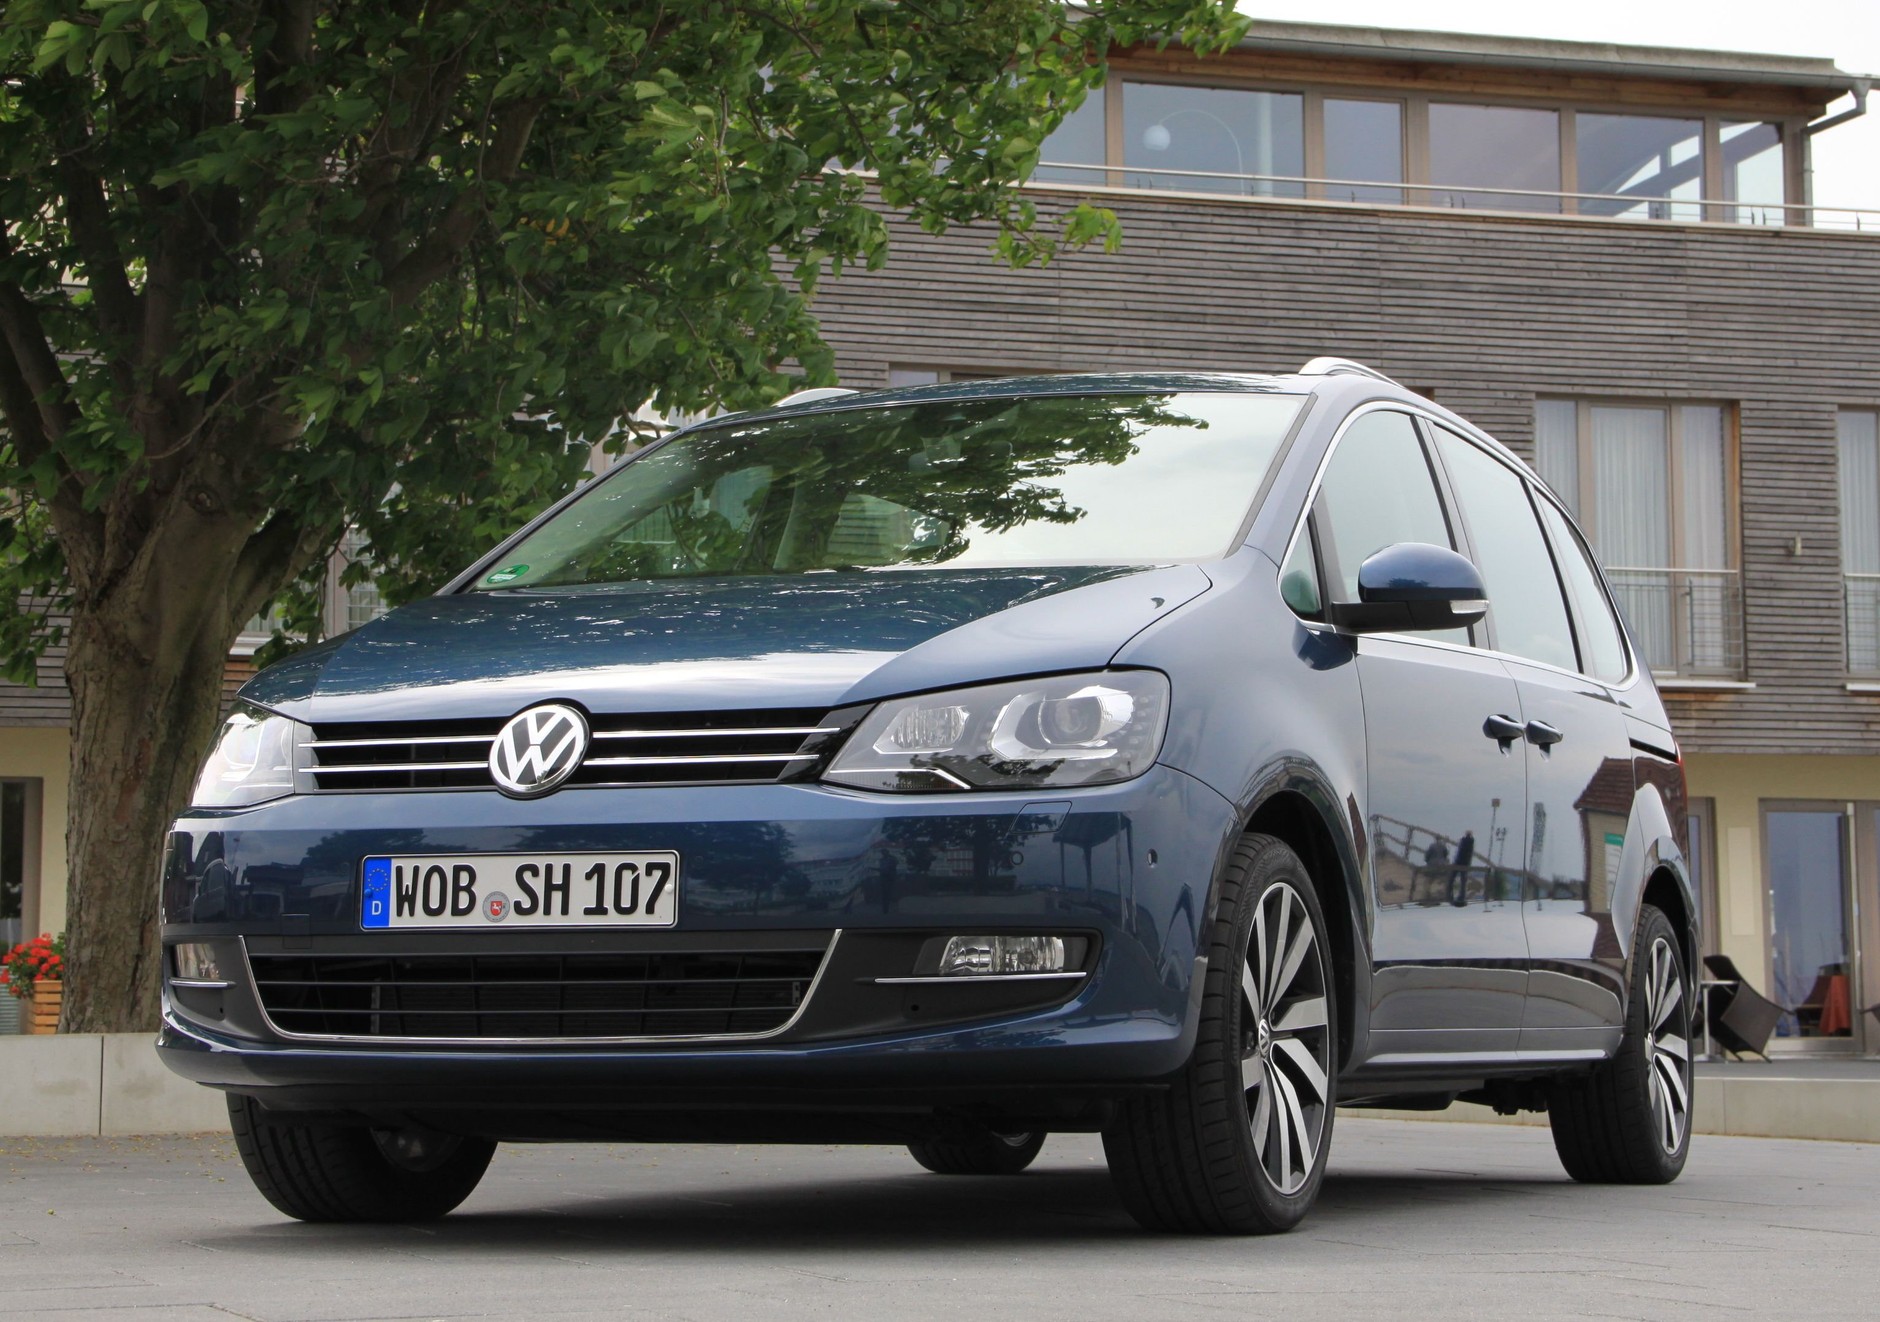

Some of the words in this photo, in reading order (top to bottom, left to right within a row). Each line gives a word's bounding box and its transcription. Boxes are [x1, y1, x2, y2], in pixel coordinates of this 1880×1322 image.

[395, 864, 477, 917] WOB
[513, 862, 572, 916] SH
[583, 861, 671, 915] 107
[371, 900, 382, 916] D
